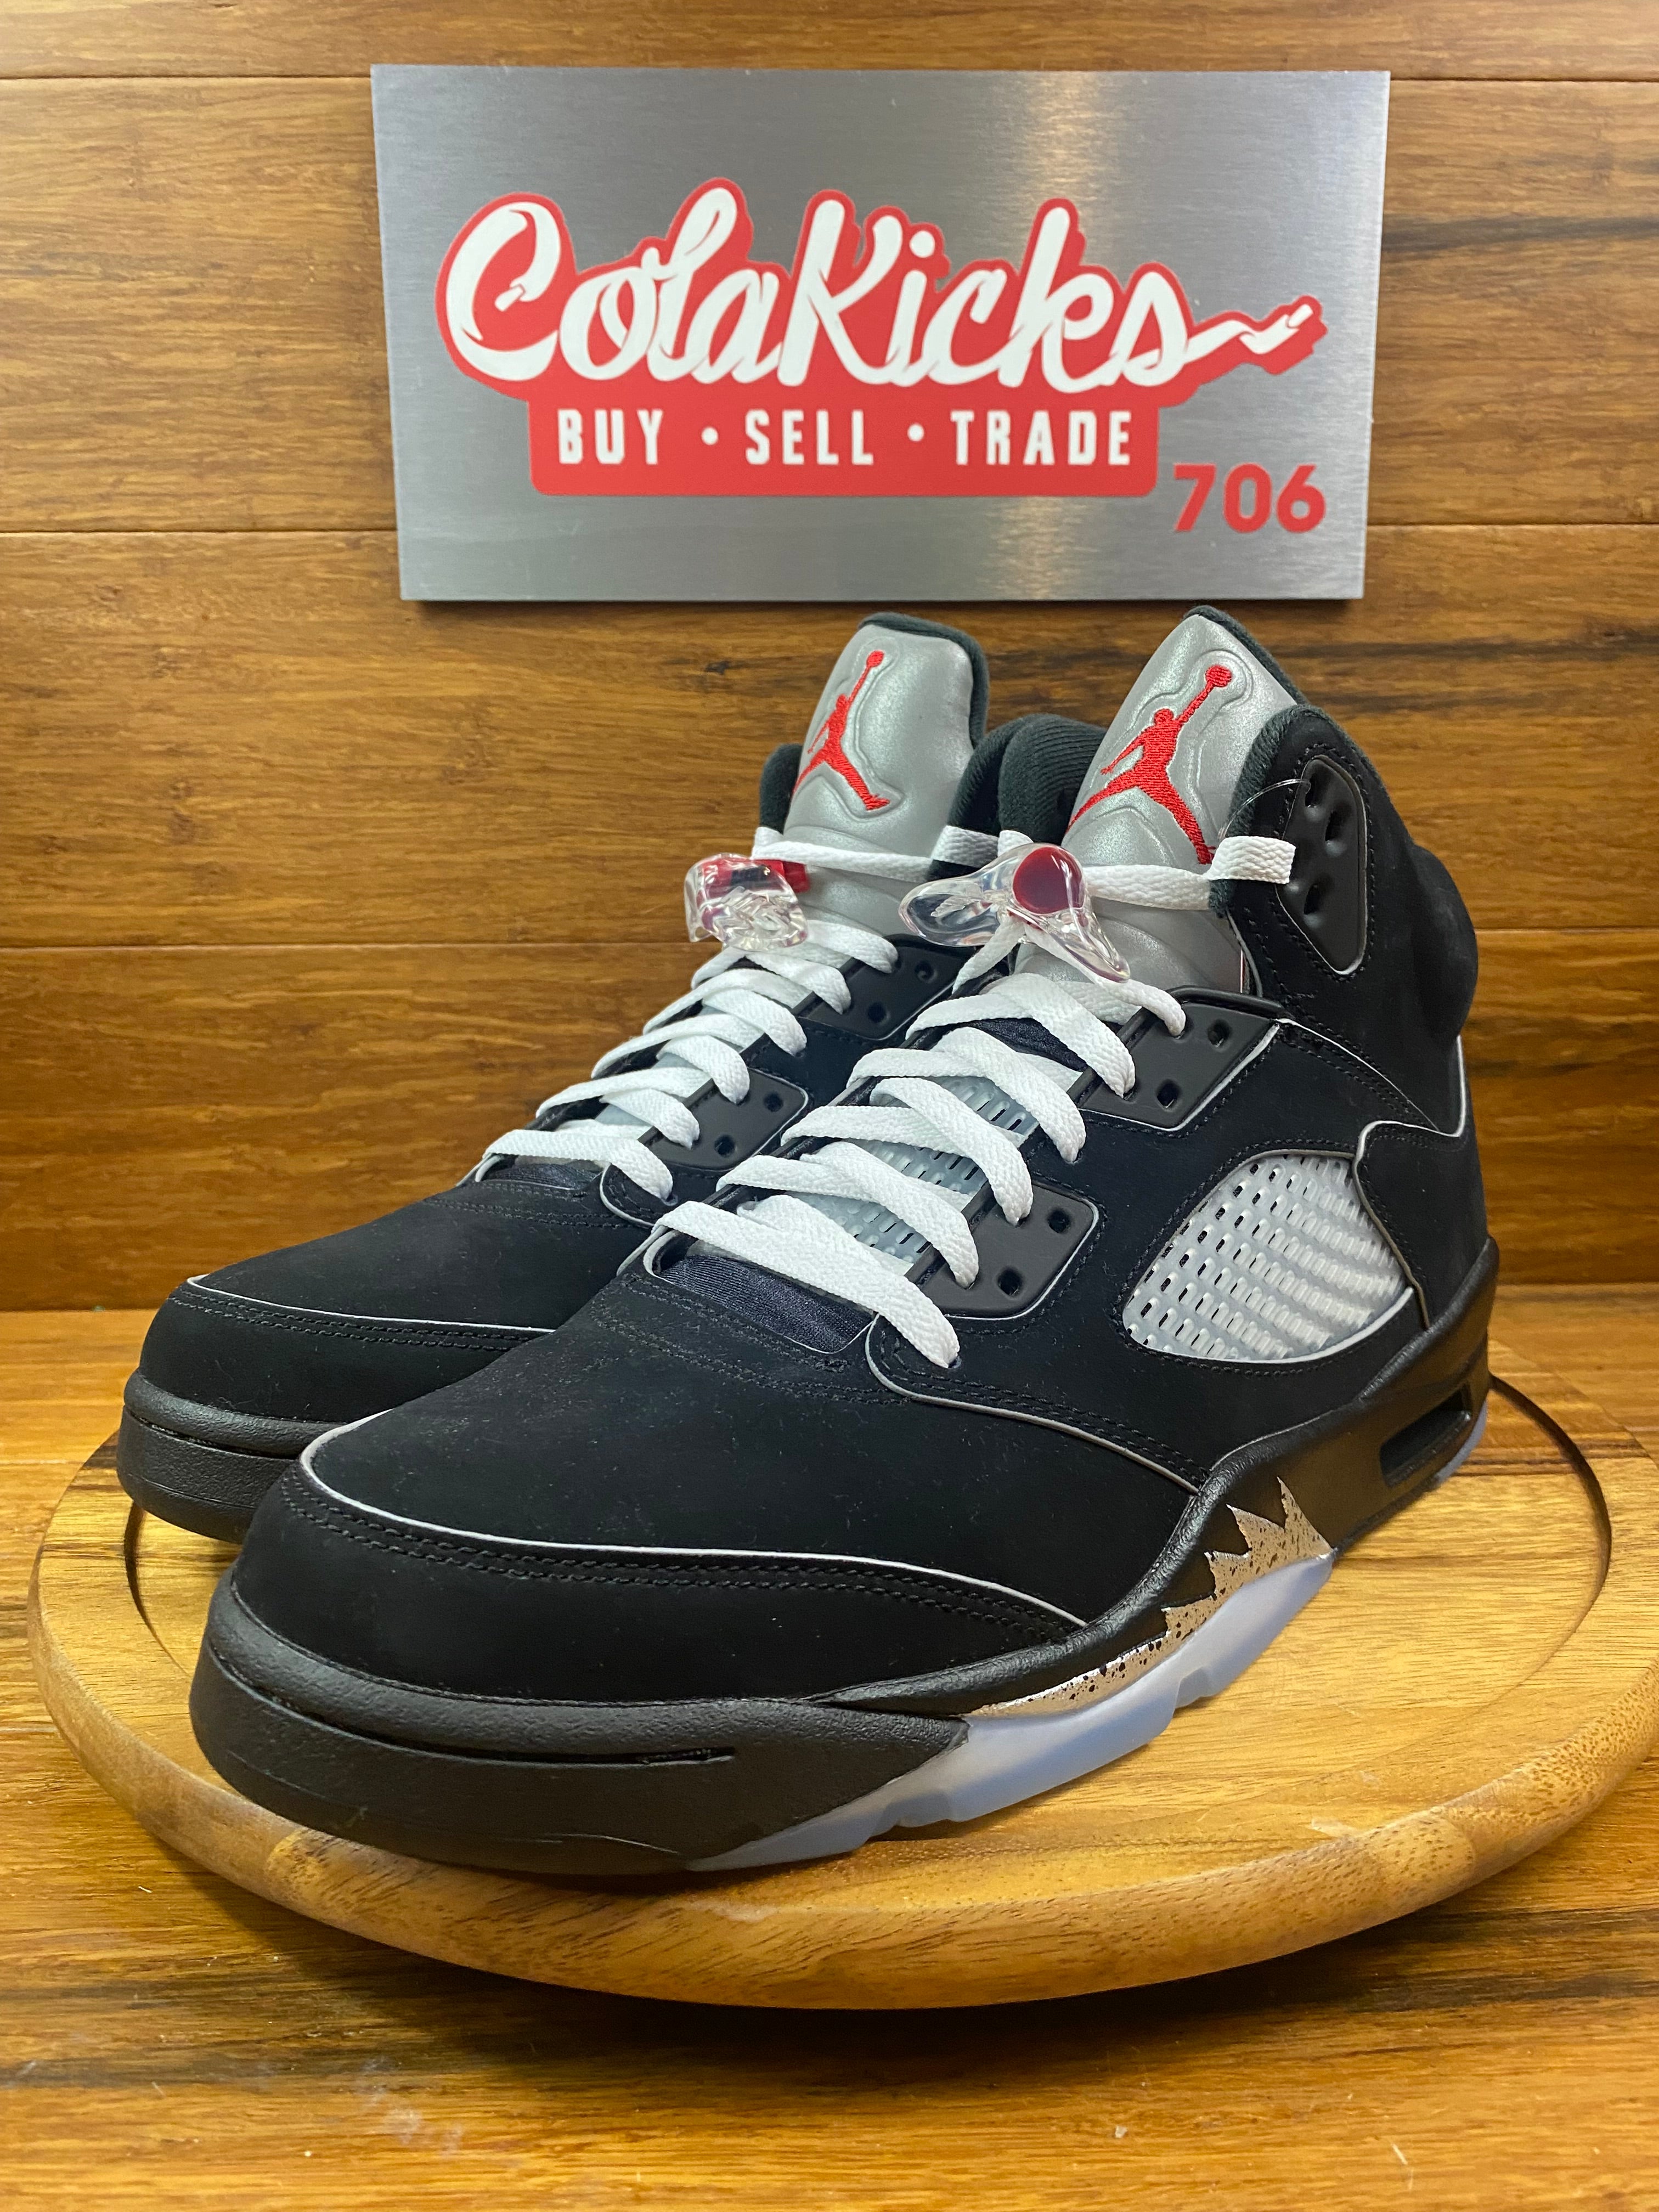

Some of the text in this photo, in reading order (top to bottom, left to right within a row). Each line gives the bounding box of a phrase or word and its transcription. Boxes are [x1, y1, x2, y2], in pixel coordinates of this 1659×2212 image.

[445, 187, 1313, 393] ColaKicks
[558, 409, 1131, 465] BUY SELL TRADE
[1173, 463, 1326, 533] 706
